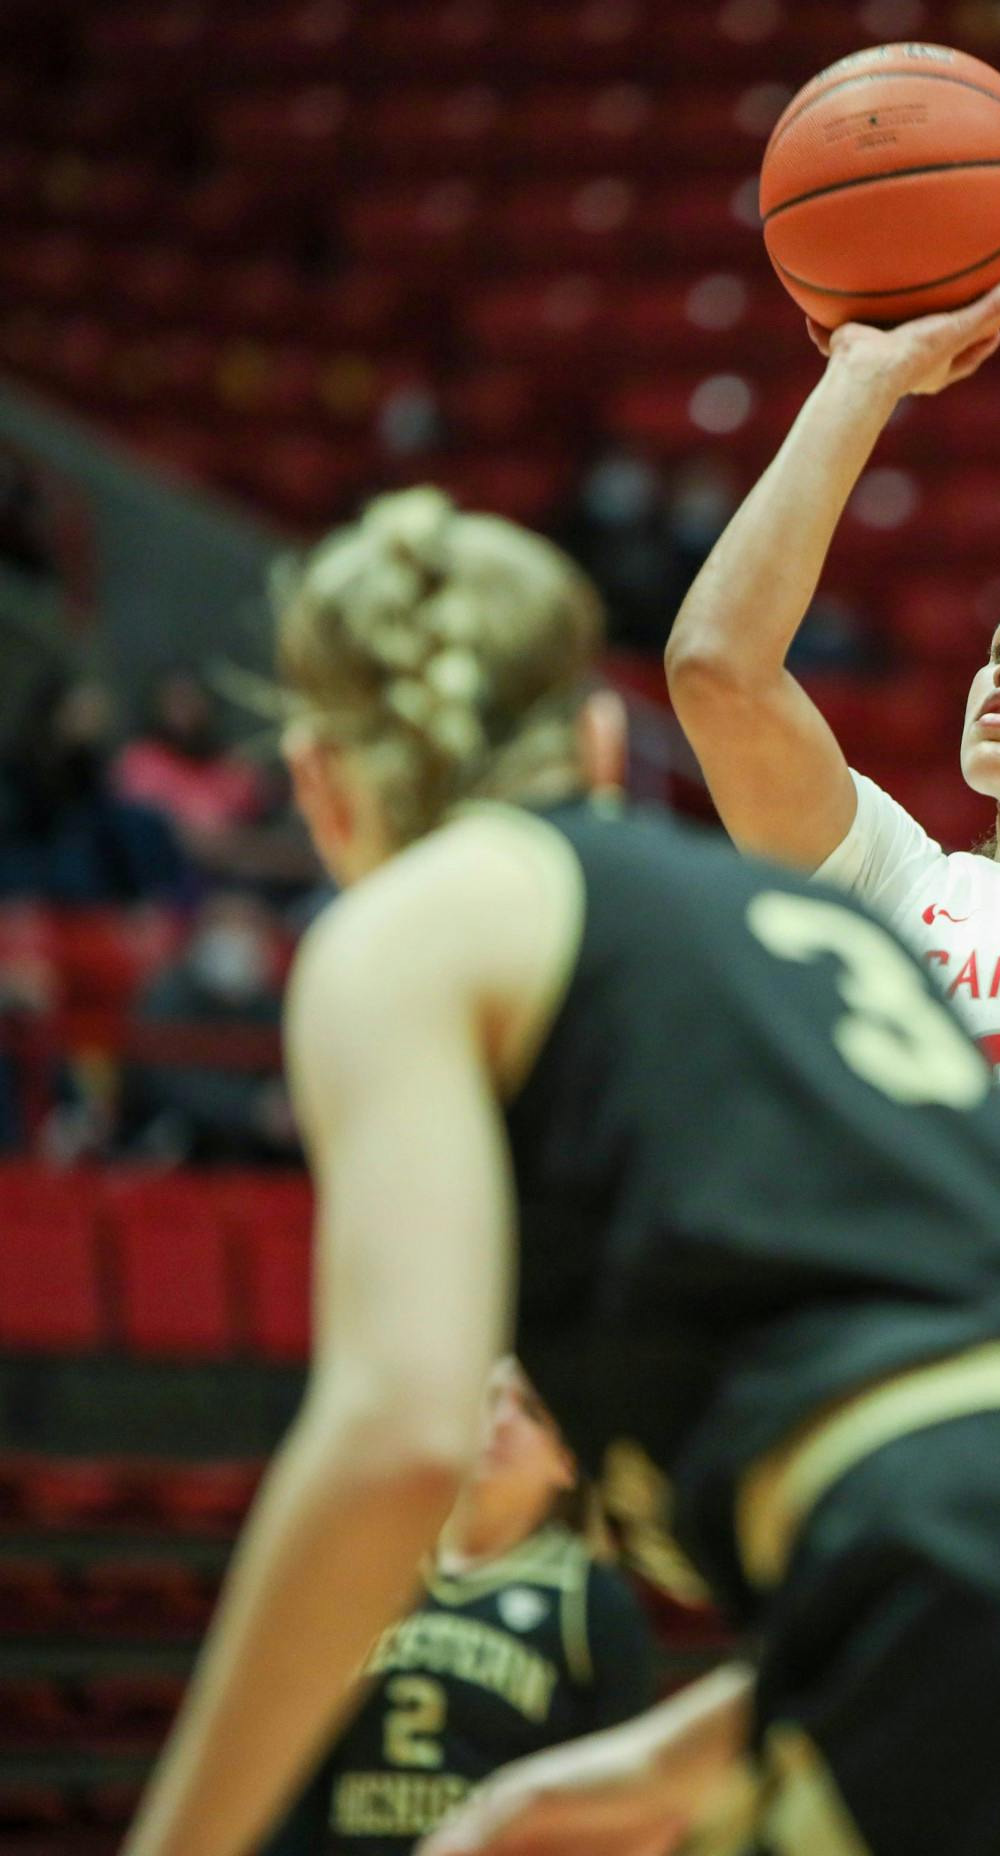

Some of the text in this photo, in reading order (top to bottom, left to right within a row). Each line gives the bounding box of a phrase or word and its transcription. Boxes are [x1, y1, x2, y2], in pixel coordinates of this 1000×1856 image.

[746, 890, 992, 1112] 3
[358, 1613, 556, 1723] ESTERN
[383, 1675, 446, 1769] 2
